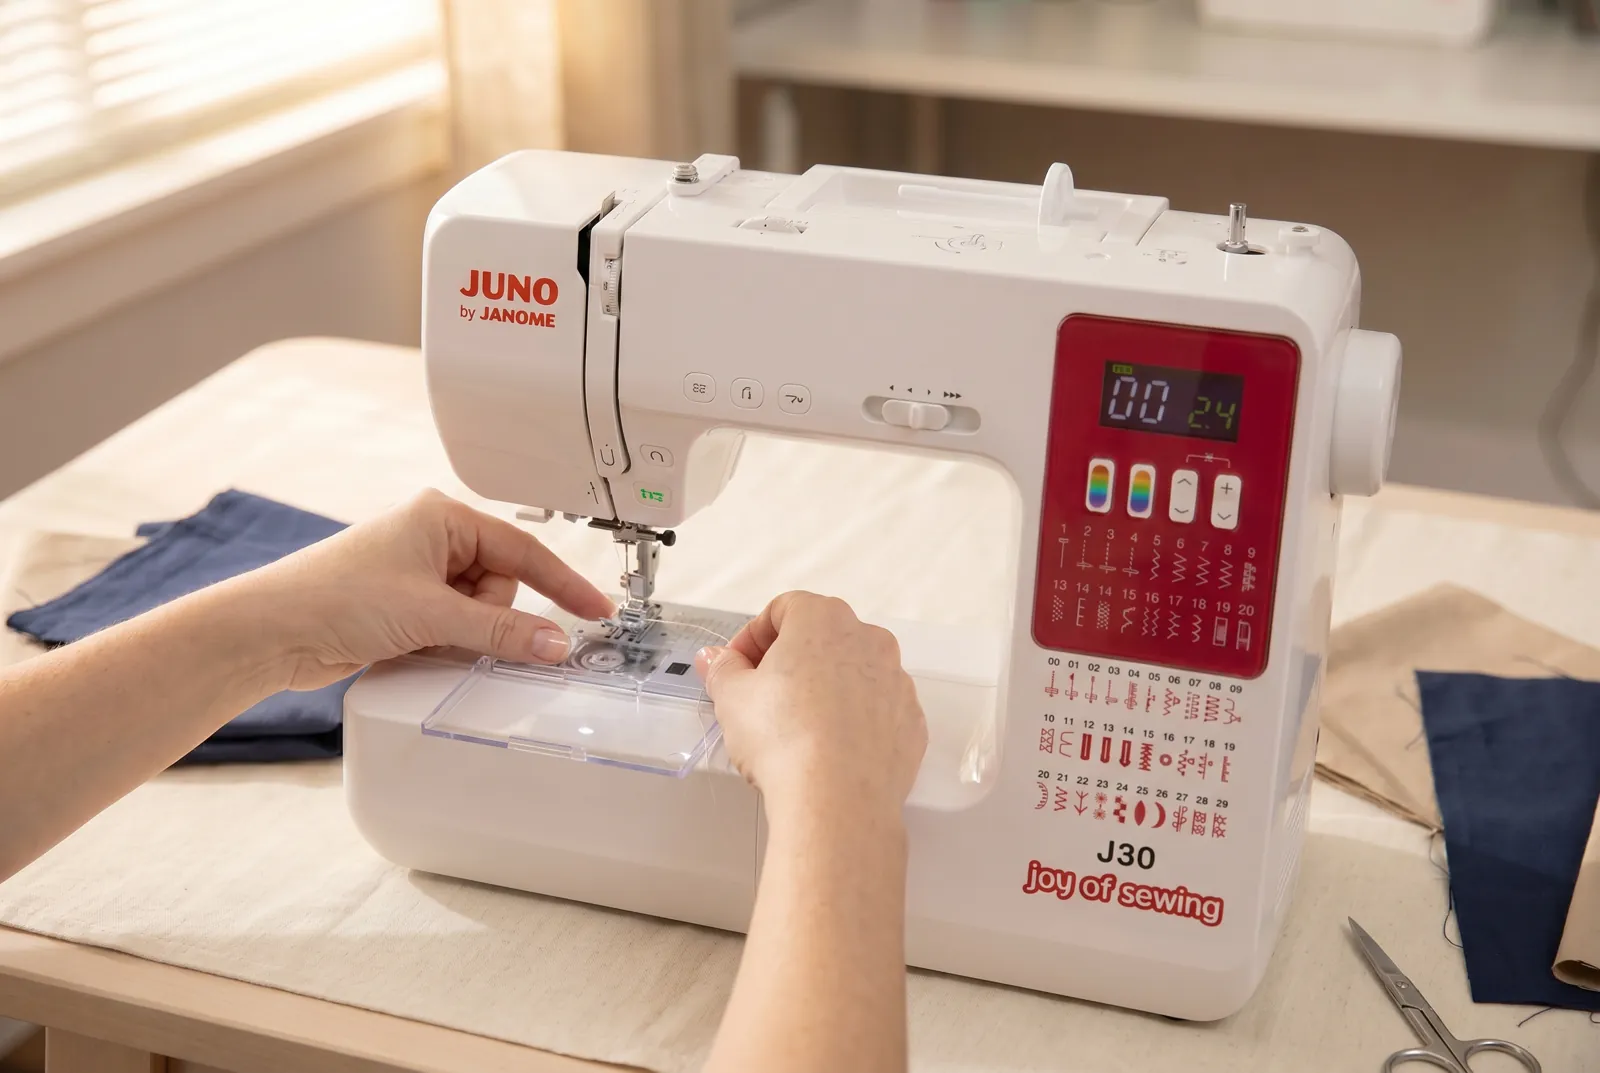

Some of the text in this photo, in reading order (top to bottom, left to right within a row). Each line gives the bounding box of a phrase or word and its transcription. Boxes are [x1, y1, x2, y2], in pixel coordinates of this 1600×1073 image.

[460, 270, 558, 305] JUNO
[460, 305, 555, 328] by JANOME
[1108, 376, 1169, 424] 00
[1061, 524, 1255, 558] 1 2 3 4 5 6 7 8 9
[1054, 580, 1254, 616] 13 14 14 15 16 17 18 19 20
[1048, 658, 1242, 694] 00 01 02 03 04 05 06 07 08 09
[1044, 714, 1235, 751] 10 11 12 13 14 15 16 17 18 19
[1038, 770, 1228, 808] 20 21 22 23 24 25 26 27 28 29
[1097, 841, 1155, 869] J30
[1024, 862, 1222, 925] joy of sewing
